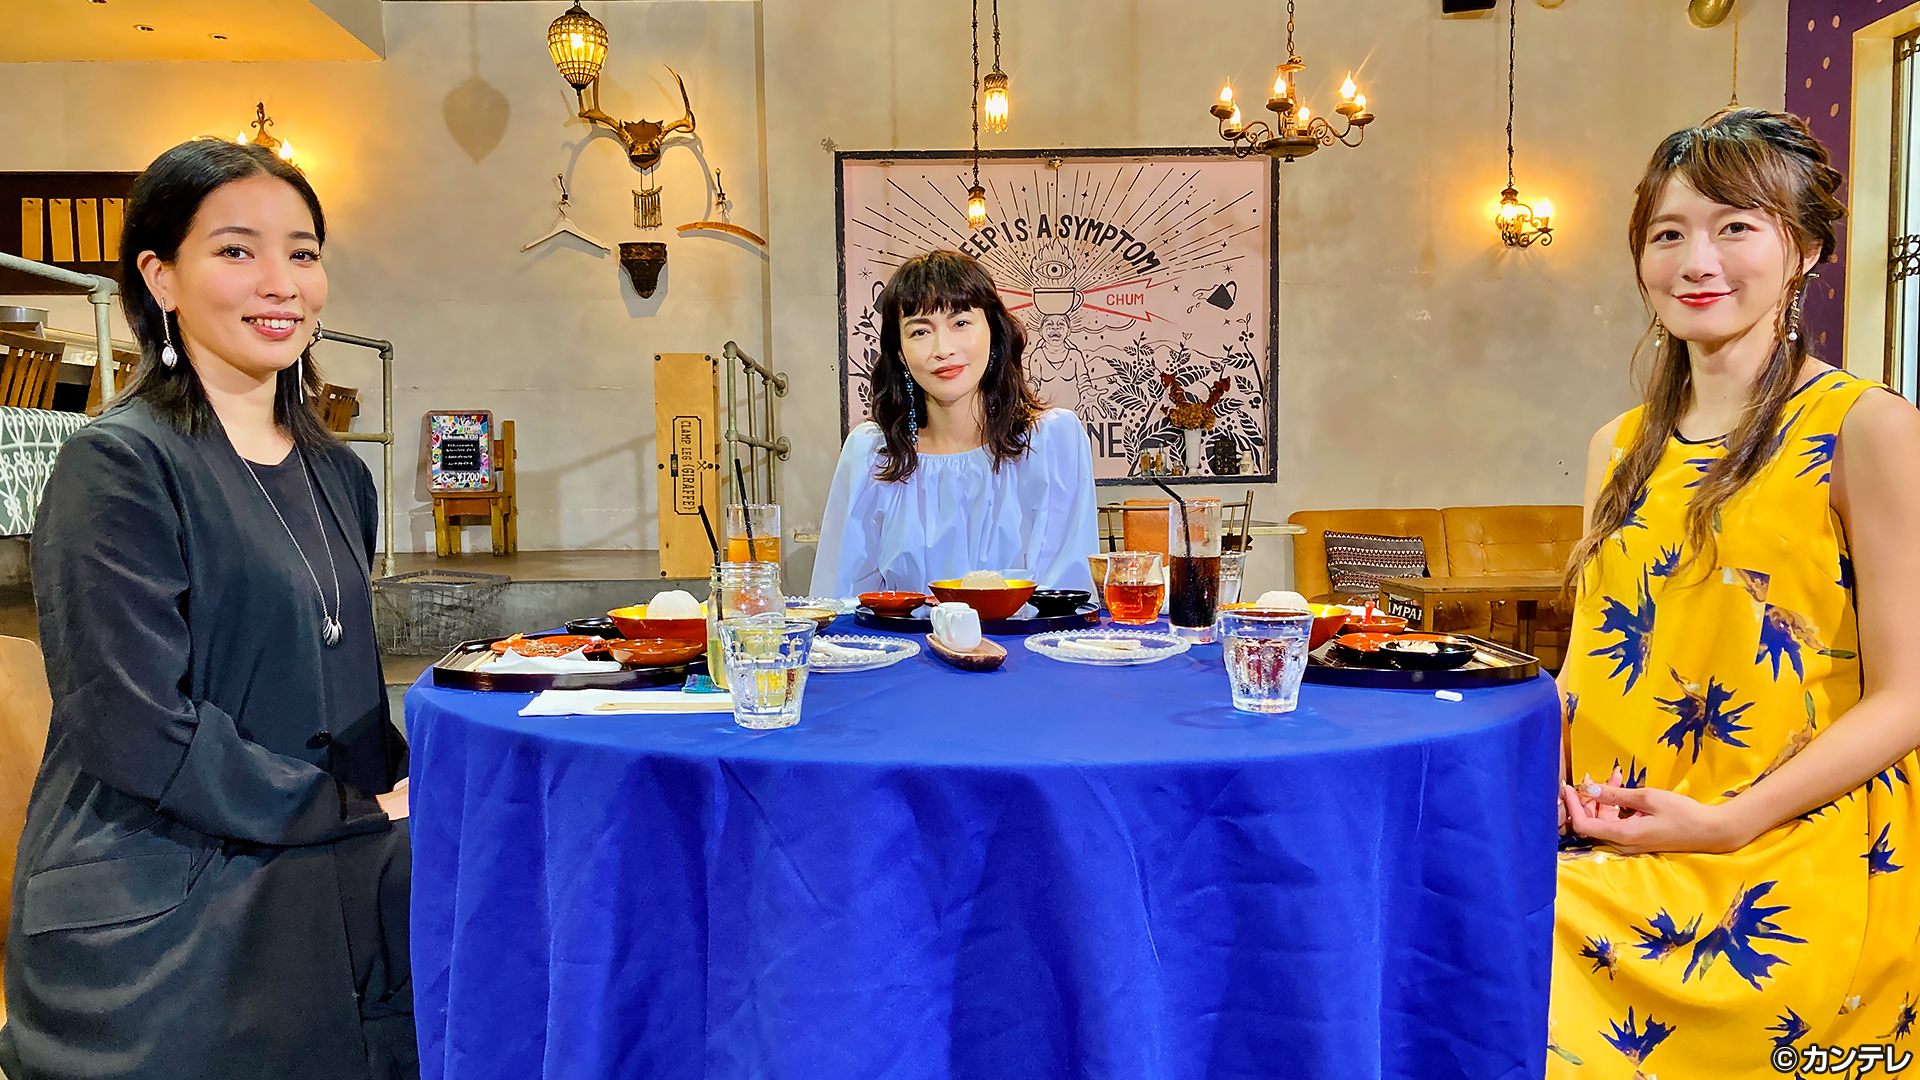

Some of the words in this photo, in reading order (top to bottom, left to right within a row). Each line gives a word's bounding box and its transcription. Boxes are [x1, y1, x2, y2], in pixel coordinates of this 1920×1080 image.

[1001, 217, 1028, 243] IS
[1037, 214, 1052, 238] A
[1058, 214, 1162, 275] SYMPTOM
[1106, 293, 1144, 306] CHUM
[680, 420, 691, 445] CLAMP
[681, 447, 692, 461] LEG
[1387, 600, 1423, 621] MPA
